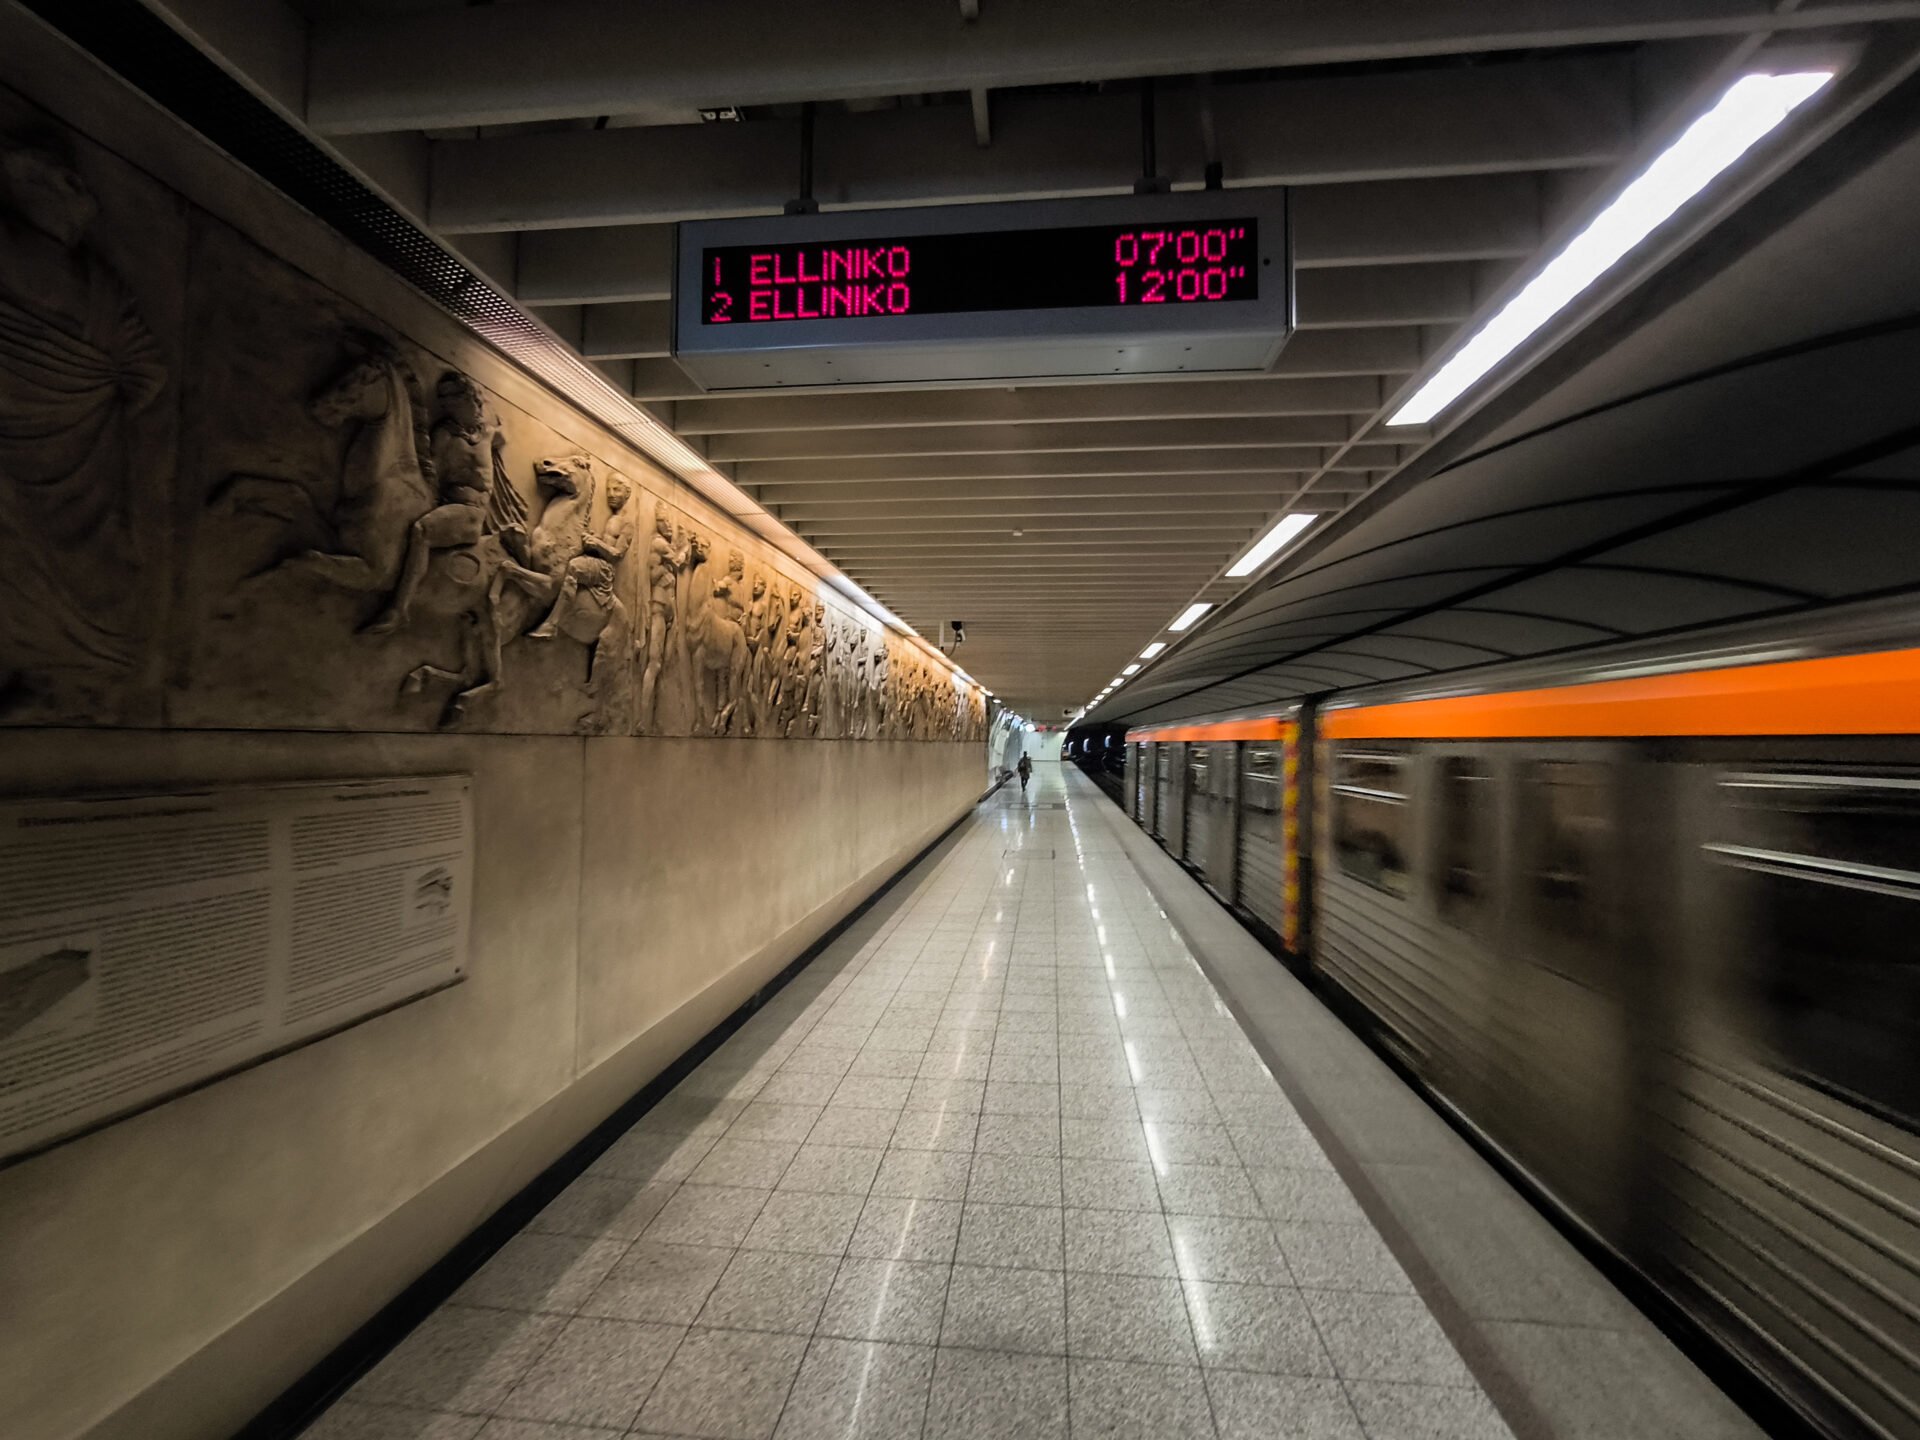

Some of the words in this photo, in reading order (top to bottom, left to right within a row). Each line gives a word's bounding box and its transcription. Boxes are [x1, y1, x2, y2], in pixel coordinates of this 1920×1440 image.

[750, 246, 910, 285] ELLINIKO
[1115, 227, 1245, 267] 07'00"
[710, 292, 733, 322] 2
[749, 282, 910, 320] ELLINIKO
